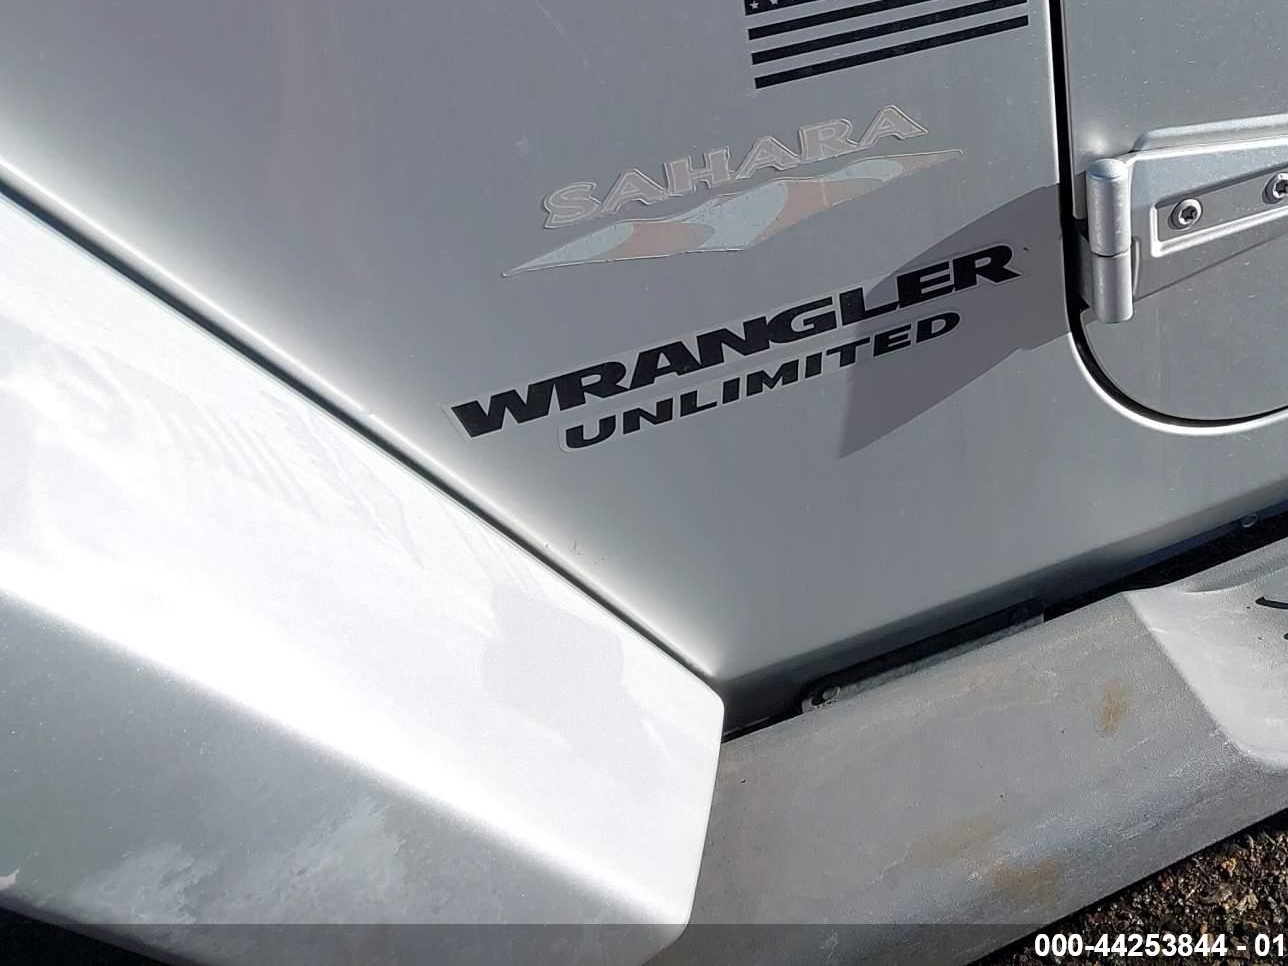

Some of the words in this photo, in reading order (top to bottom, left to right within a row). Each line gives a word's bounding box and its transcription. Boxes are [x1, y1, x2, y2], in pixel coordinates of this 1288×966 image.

[544, 104, 928, 229] SAHARA
[451, 245, 1021, 438] WRANGLER
[565, 311, 961, 449] UNLIMITED
